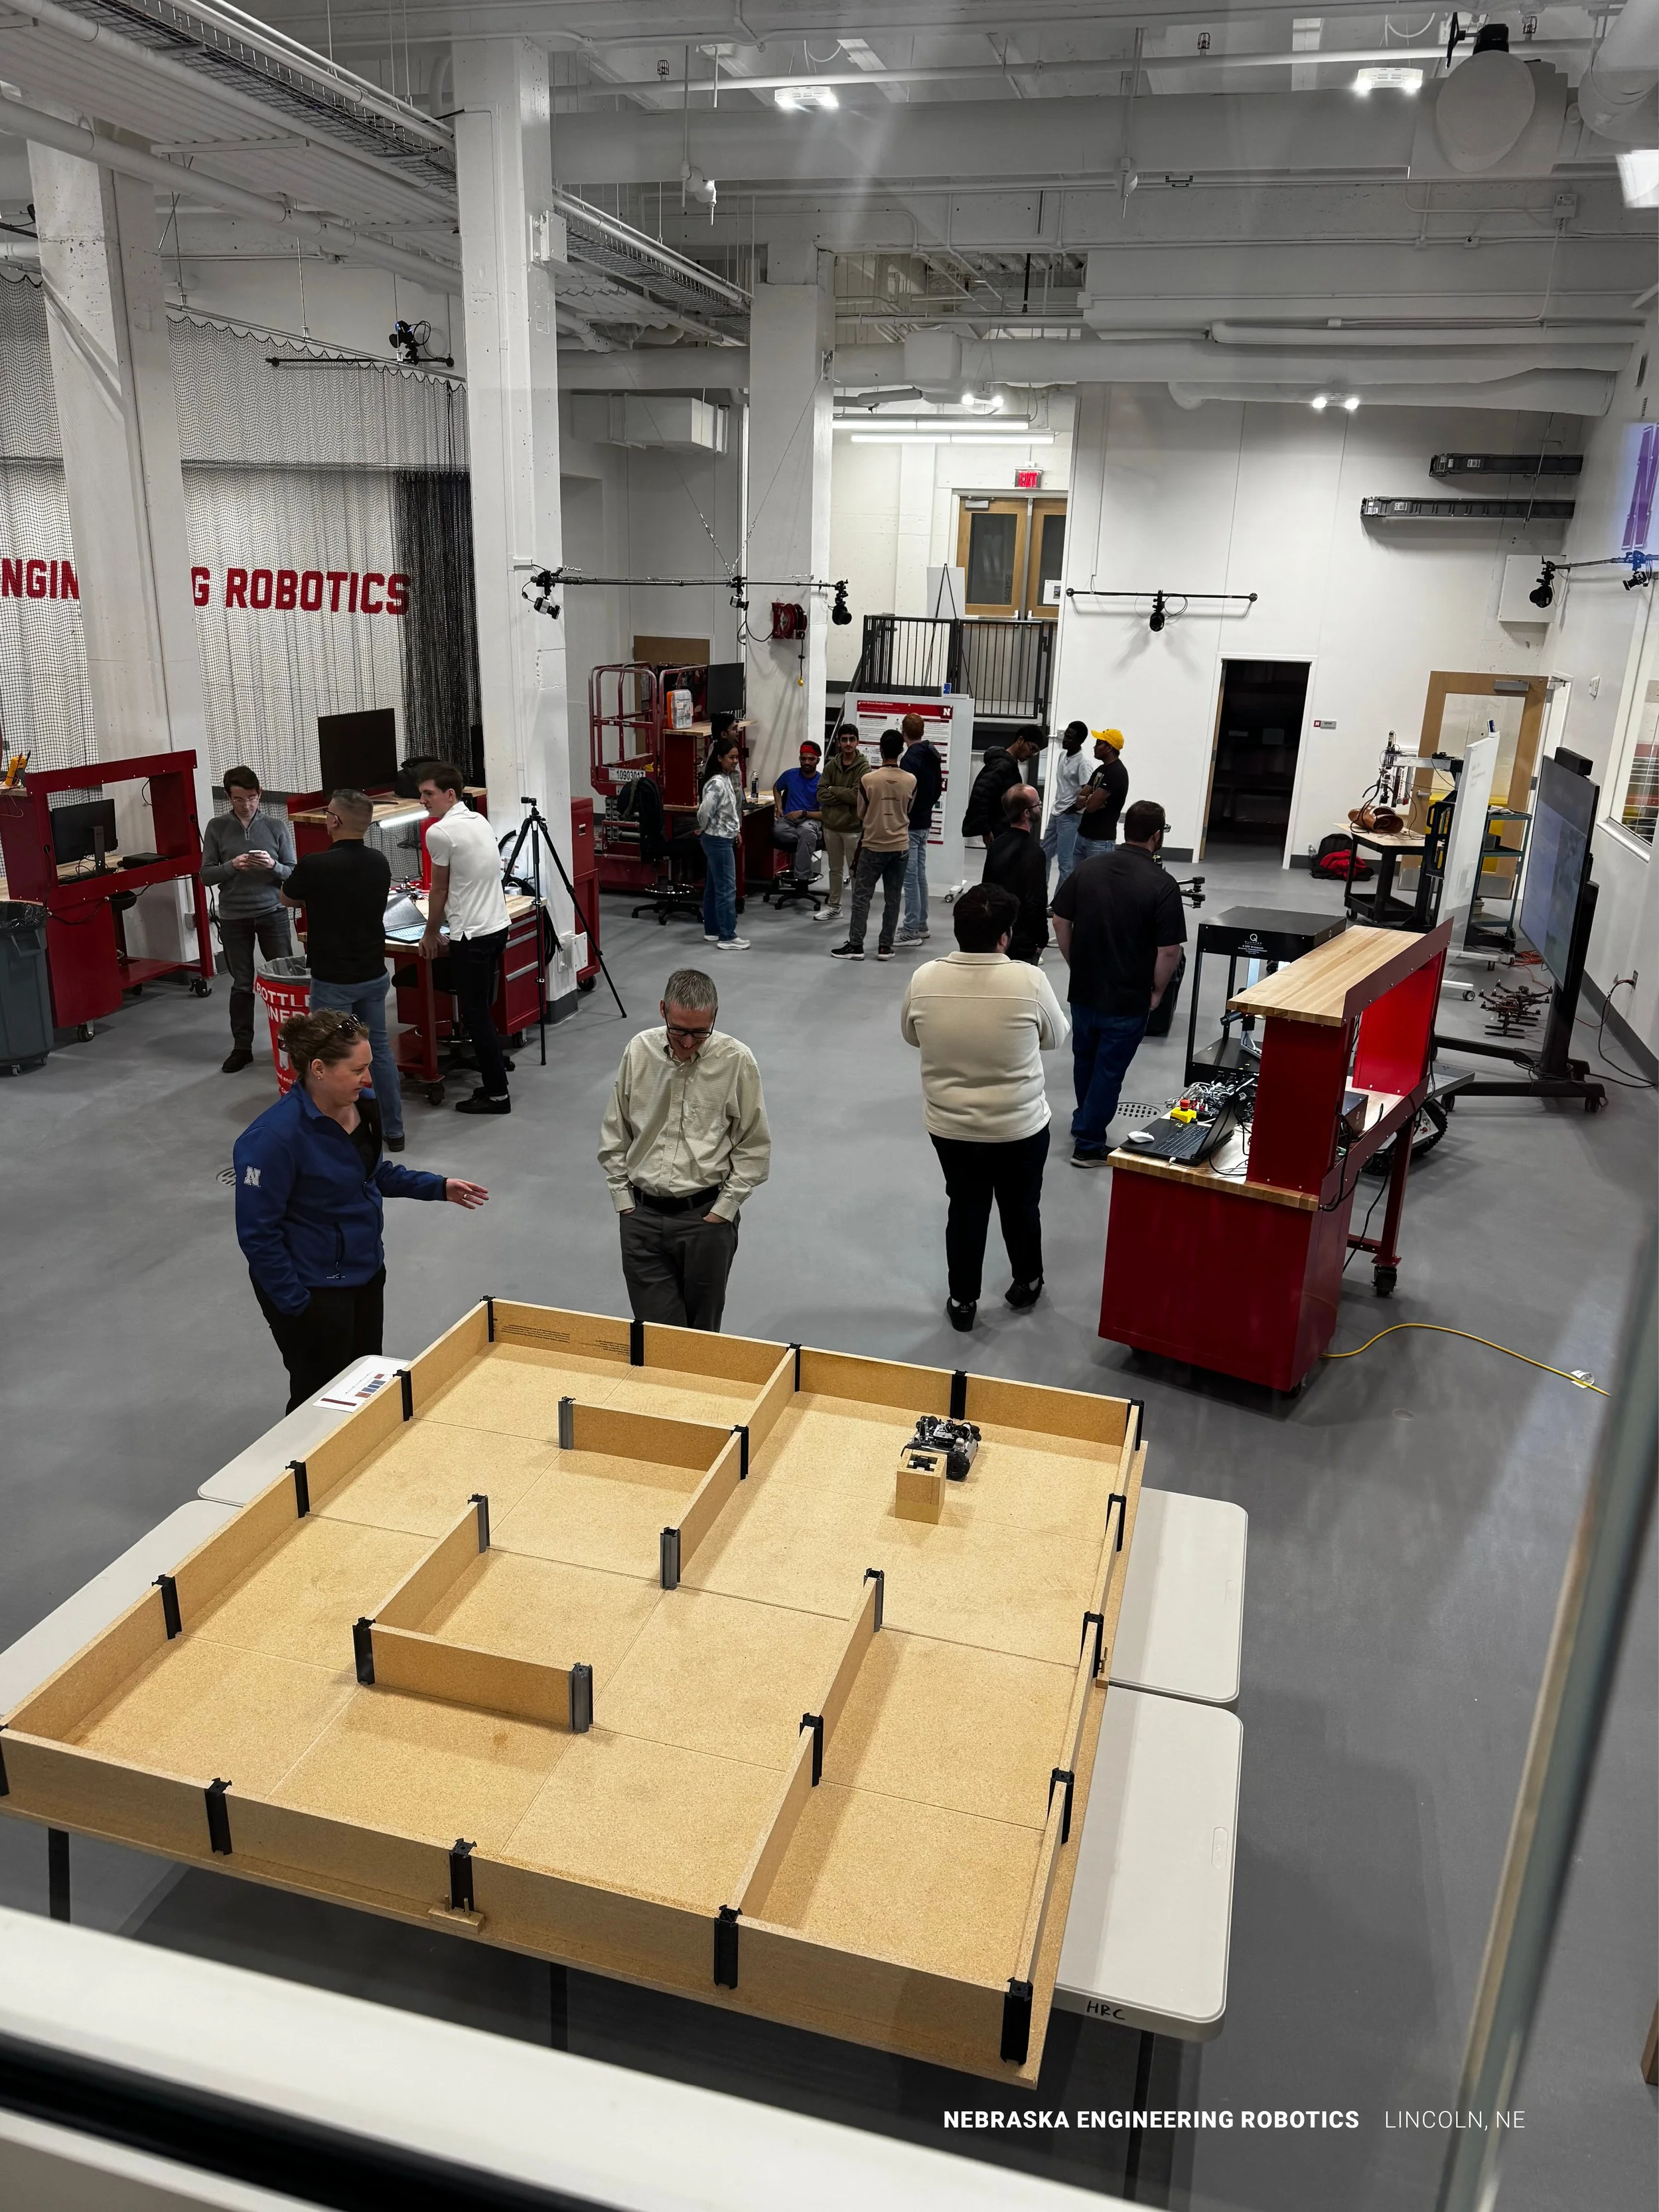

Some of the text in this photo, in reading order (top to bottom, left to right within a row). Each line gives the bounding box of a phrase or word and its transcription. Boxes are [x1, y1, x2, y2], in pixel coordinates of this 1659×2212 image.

[225, 567, 410, 615] ROBOTICS
[943, 707, 951, 716] N
[244, 1165, 261, 1187] N
[1086, 2000, 1126, 2021] HRC
